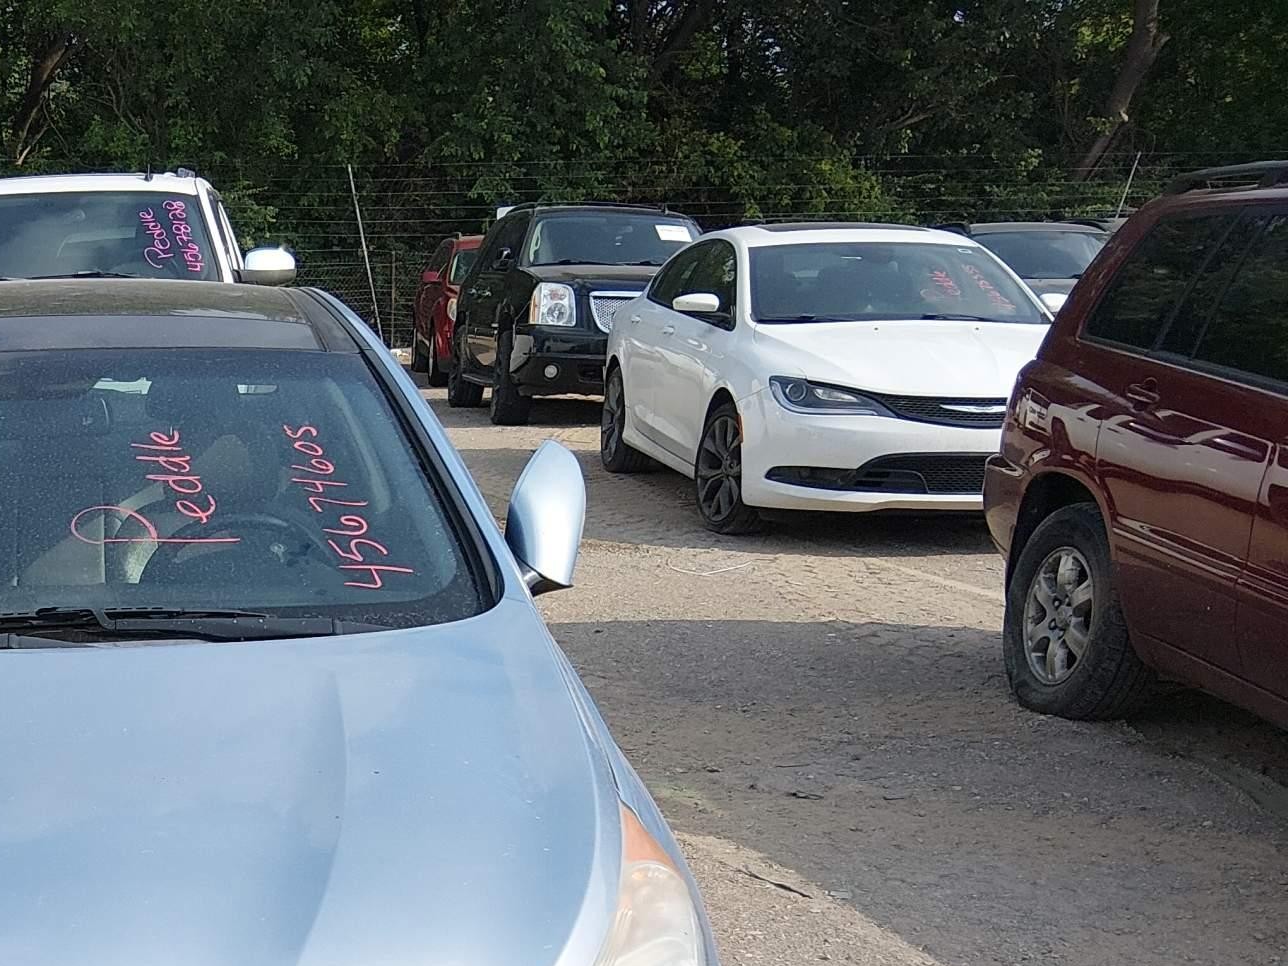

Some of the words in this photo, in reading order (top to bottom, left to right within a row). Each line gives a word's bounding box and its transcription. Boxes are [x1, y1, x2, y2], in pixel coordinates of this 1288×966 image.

[138, 207, 175, 269] Peddle
[70, 425, 241, 545] Peddle
[282, 424, 414, 589] 45674605
